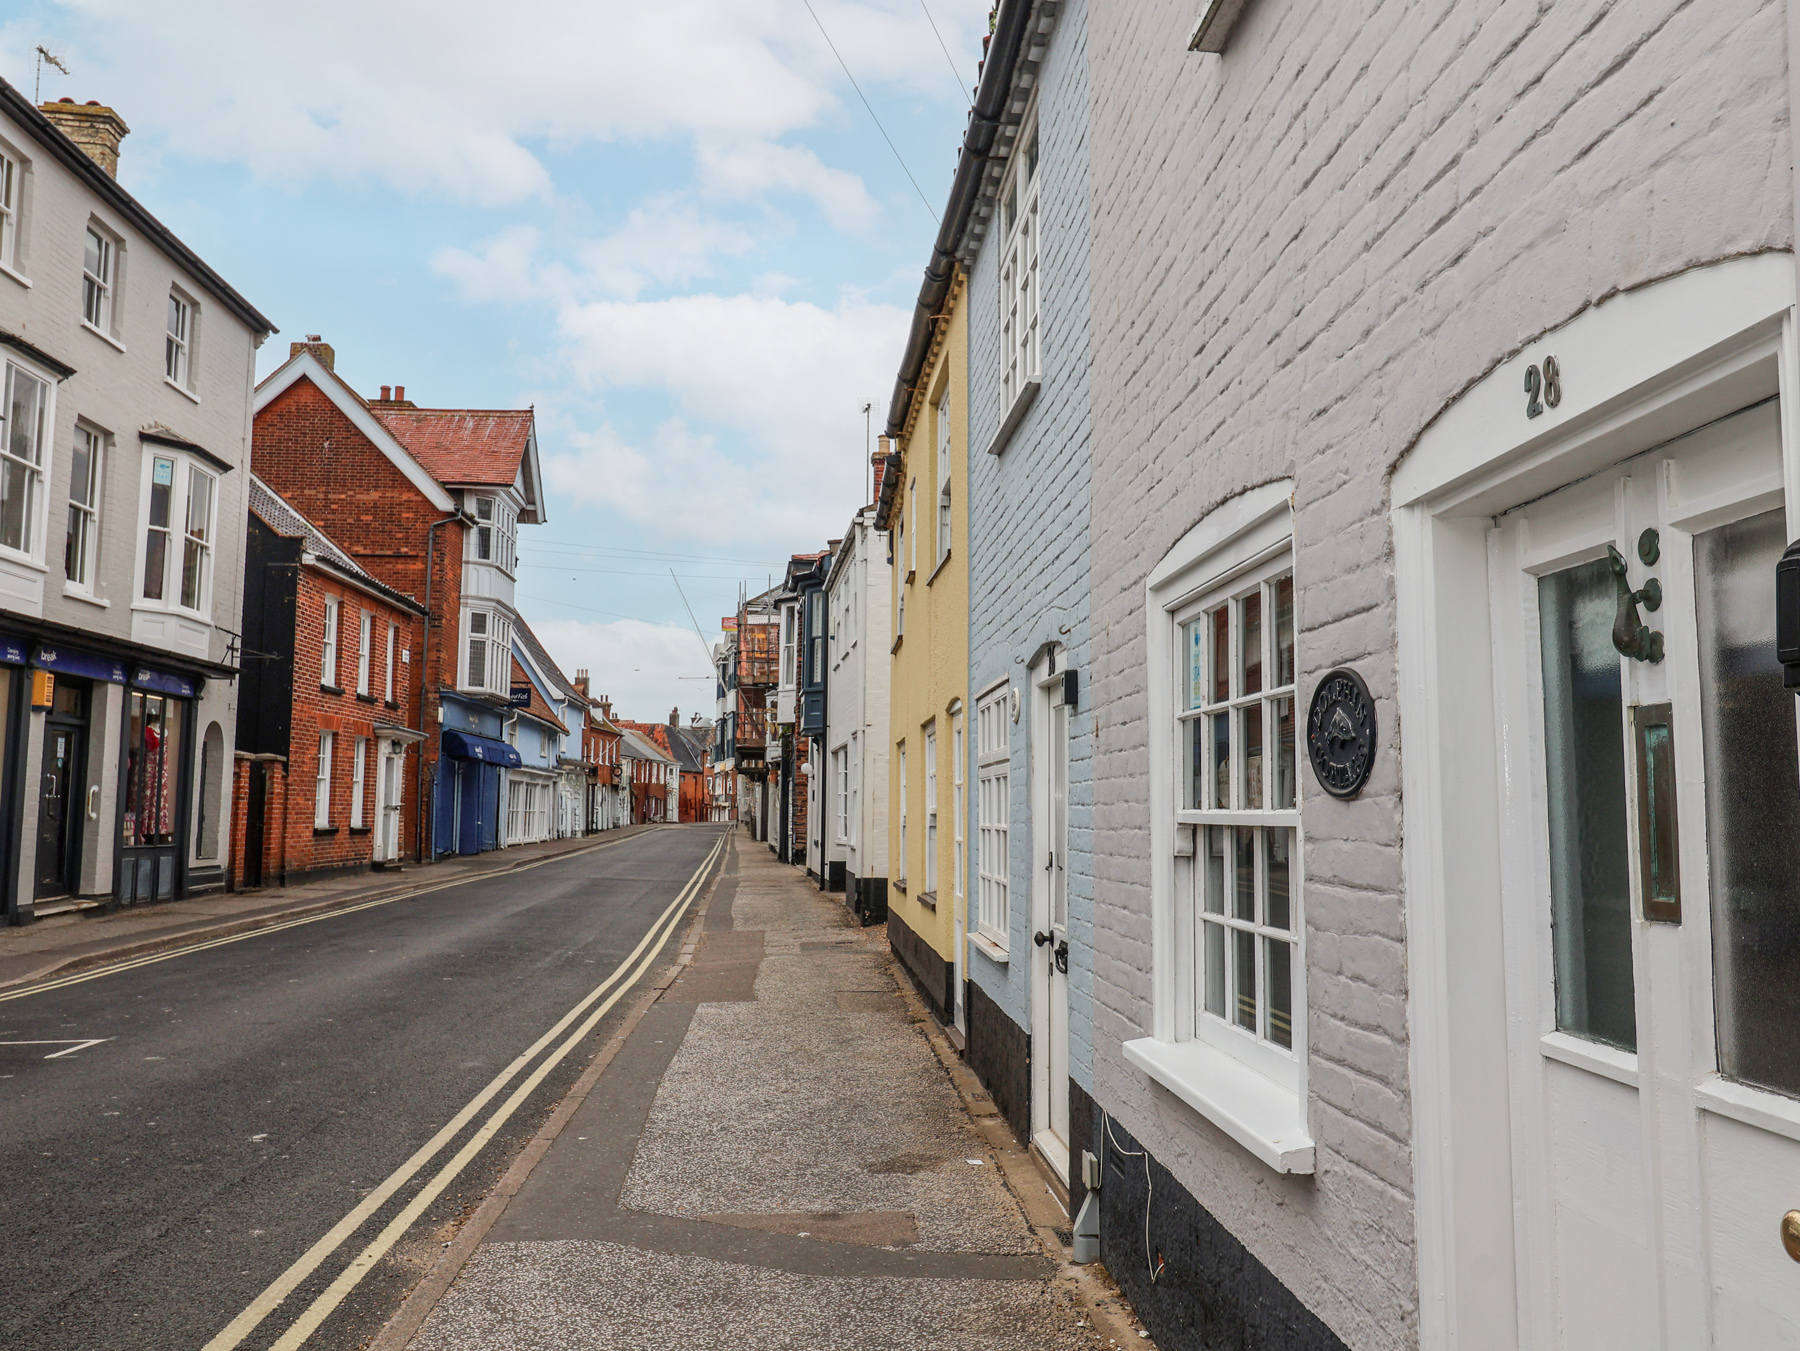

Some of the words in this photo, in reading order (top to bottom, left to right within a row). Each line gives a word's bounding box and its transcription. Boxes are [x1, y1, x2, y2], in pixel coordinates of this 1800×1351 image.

[1524, 354, 1562, 420] 28
[40, 649, 57, 662] break
[1047, 644, 1056, 677] 26
[1313, 679, 1367, 730] DOLPHIN
[1315, 739, 1368, 787] COTTAGE
